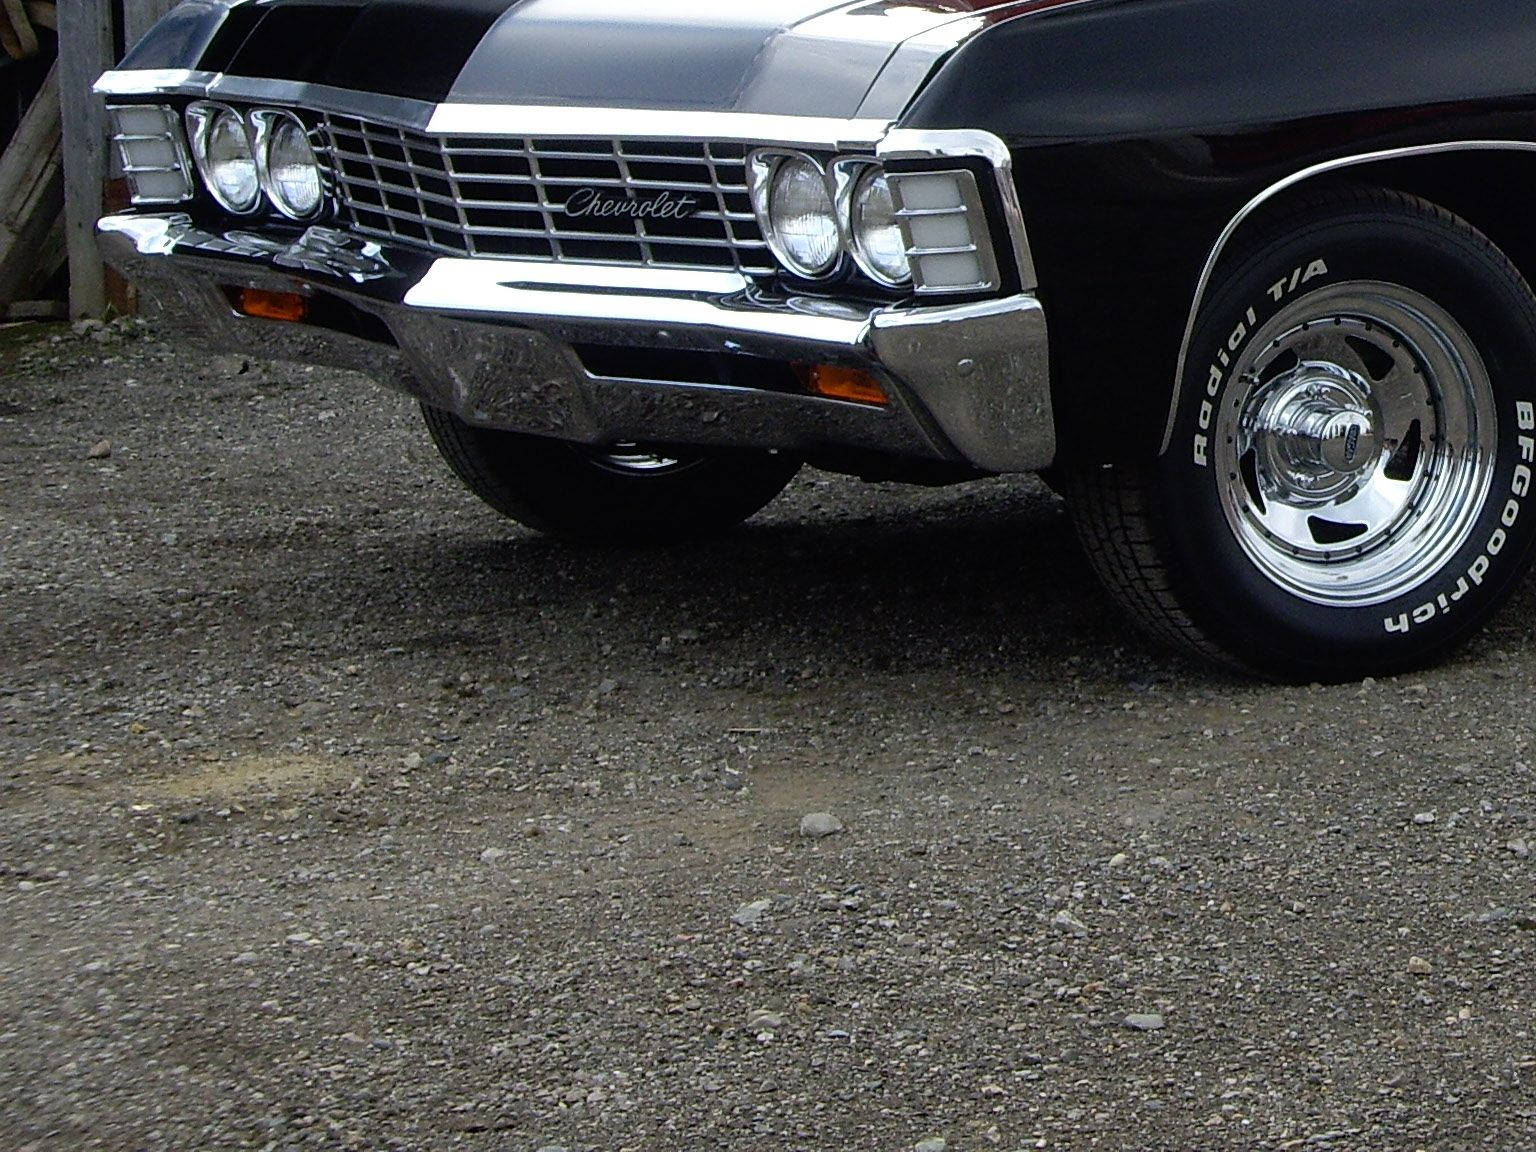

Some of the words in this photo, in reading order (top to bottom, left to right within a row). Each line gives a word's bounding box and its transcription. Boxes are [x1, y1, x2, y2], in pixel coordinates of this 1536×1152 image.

[564, 187, 697, 220] Chevrolet
[1194, 306, 1258, 467] Radial
[1266, 258, 1329, 303] T/A
[1383, 400, 1536, 635] BFGoodrich
